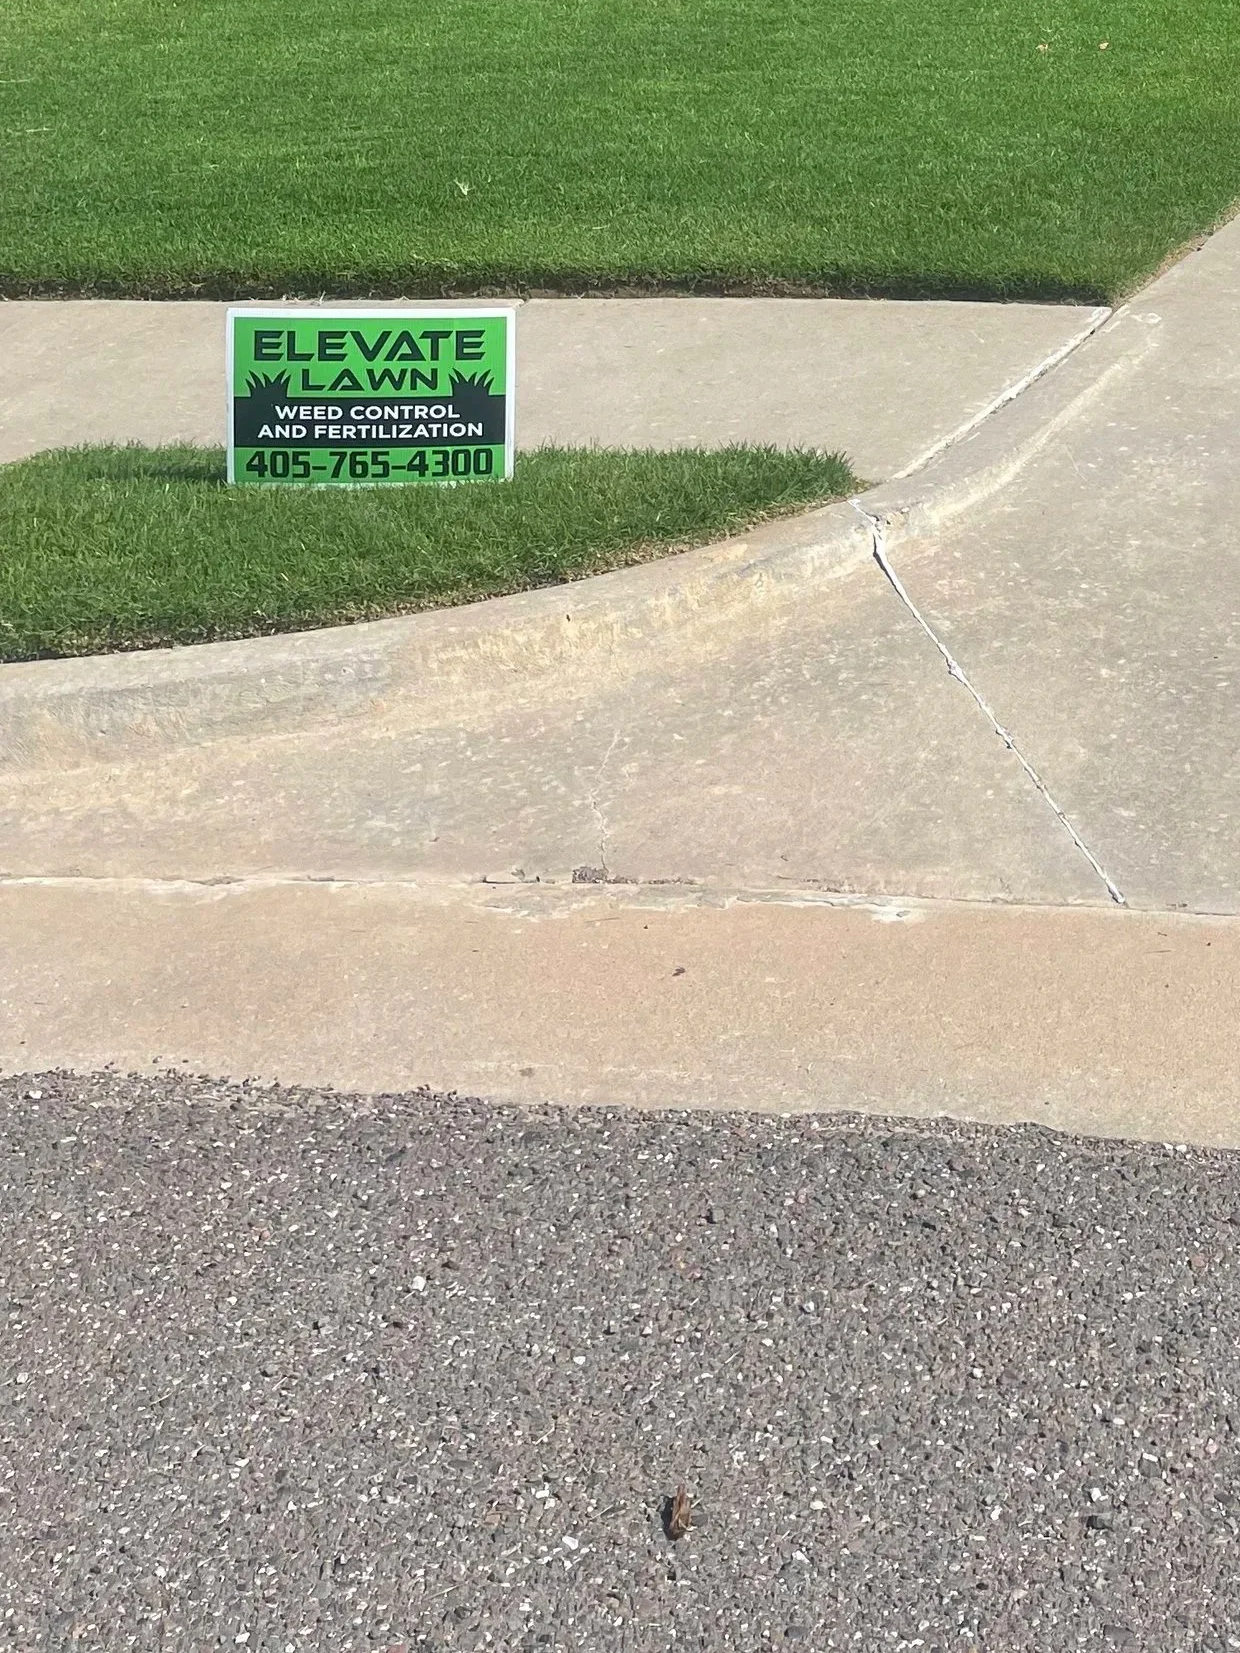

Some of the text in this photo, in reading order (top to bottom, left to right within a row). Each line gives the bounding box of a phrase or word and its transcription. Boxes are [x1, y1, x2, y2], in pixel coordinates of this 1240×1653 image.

[253, 330, 486, 362] ELEVATE
[301, 368, 438, 391] LAWN
[275, 405, 460, 420] WEED CONTROL
[257, 423, 483, 439] AND FERTILIZATION
[246, 448, 493, 478] 405-765-4300
